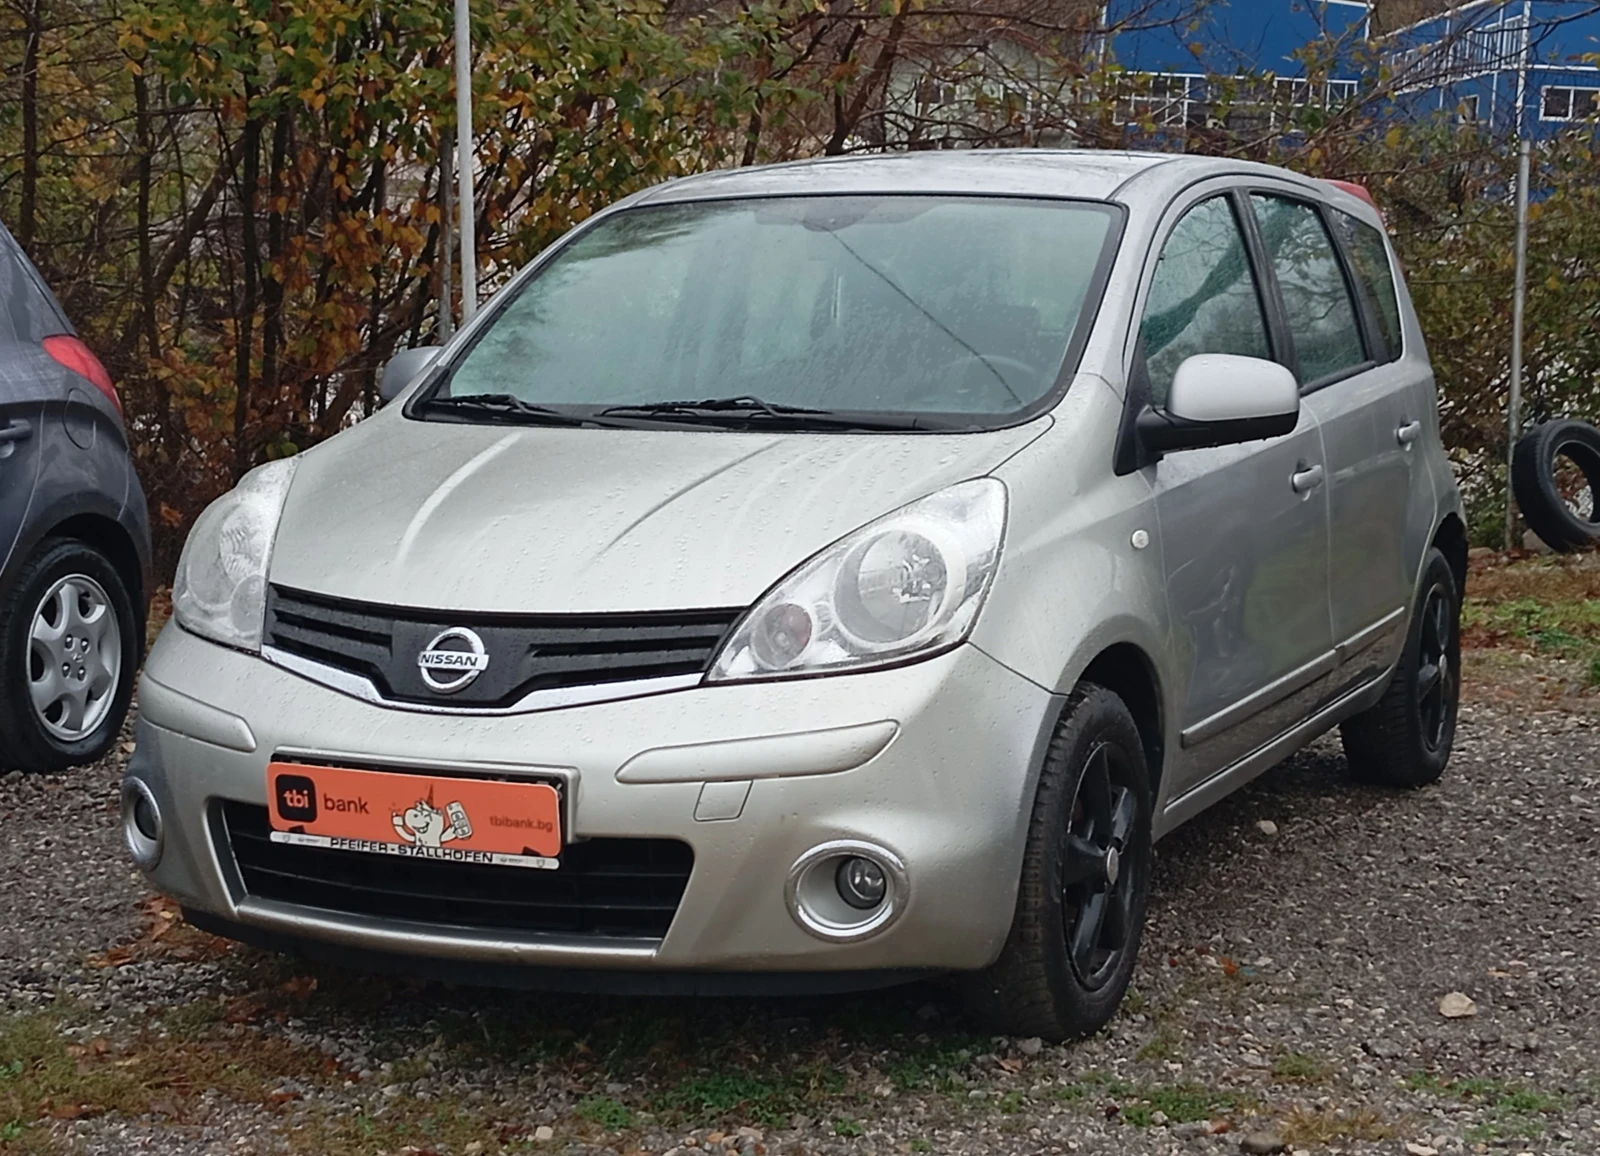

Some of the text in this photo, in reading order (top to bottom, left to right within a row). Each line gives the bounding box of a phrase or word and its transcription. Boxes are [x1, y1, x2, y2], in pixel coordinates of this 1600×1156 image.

[420, 654, 478, 667] NISSAN
[283, 789, 369, 814] tbi bank
[489, 815, 553, 833] tbibank.bg
